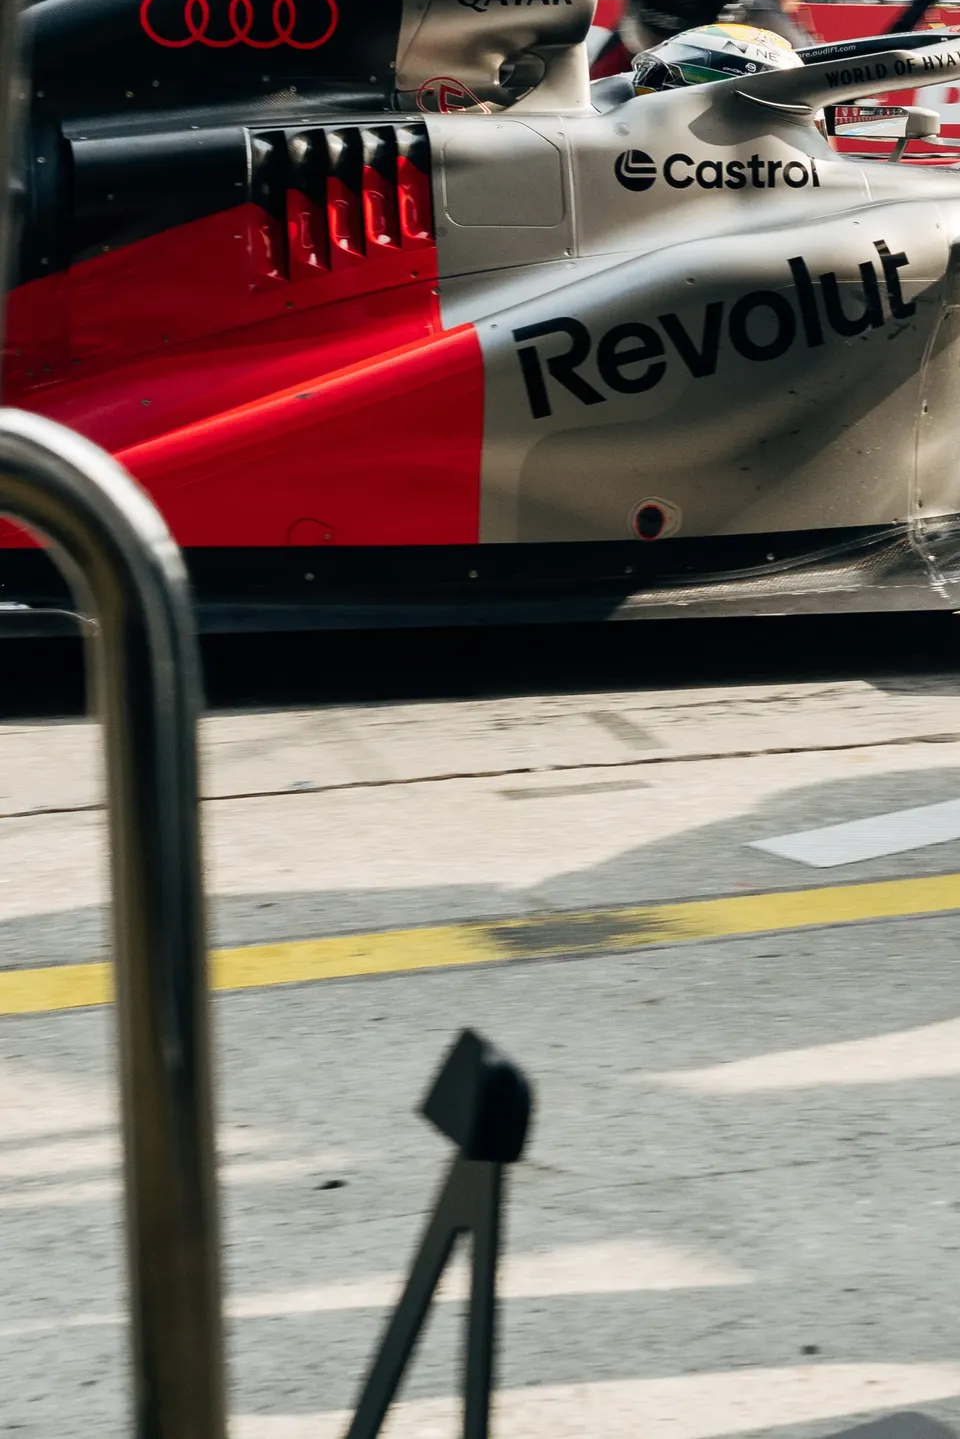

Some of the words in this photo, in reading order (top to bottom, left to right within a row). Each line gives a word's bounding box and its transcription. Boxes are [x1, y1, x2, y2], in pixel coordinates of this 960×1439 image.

[797, 44, 856, 59] ore.audif1.com
[825, 63, 887, 88] WORLD
[895, 57, 916, 77] OF
[662, 152, 821, 190] Castrol
[512, 239, 917, 420] Revolut
